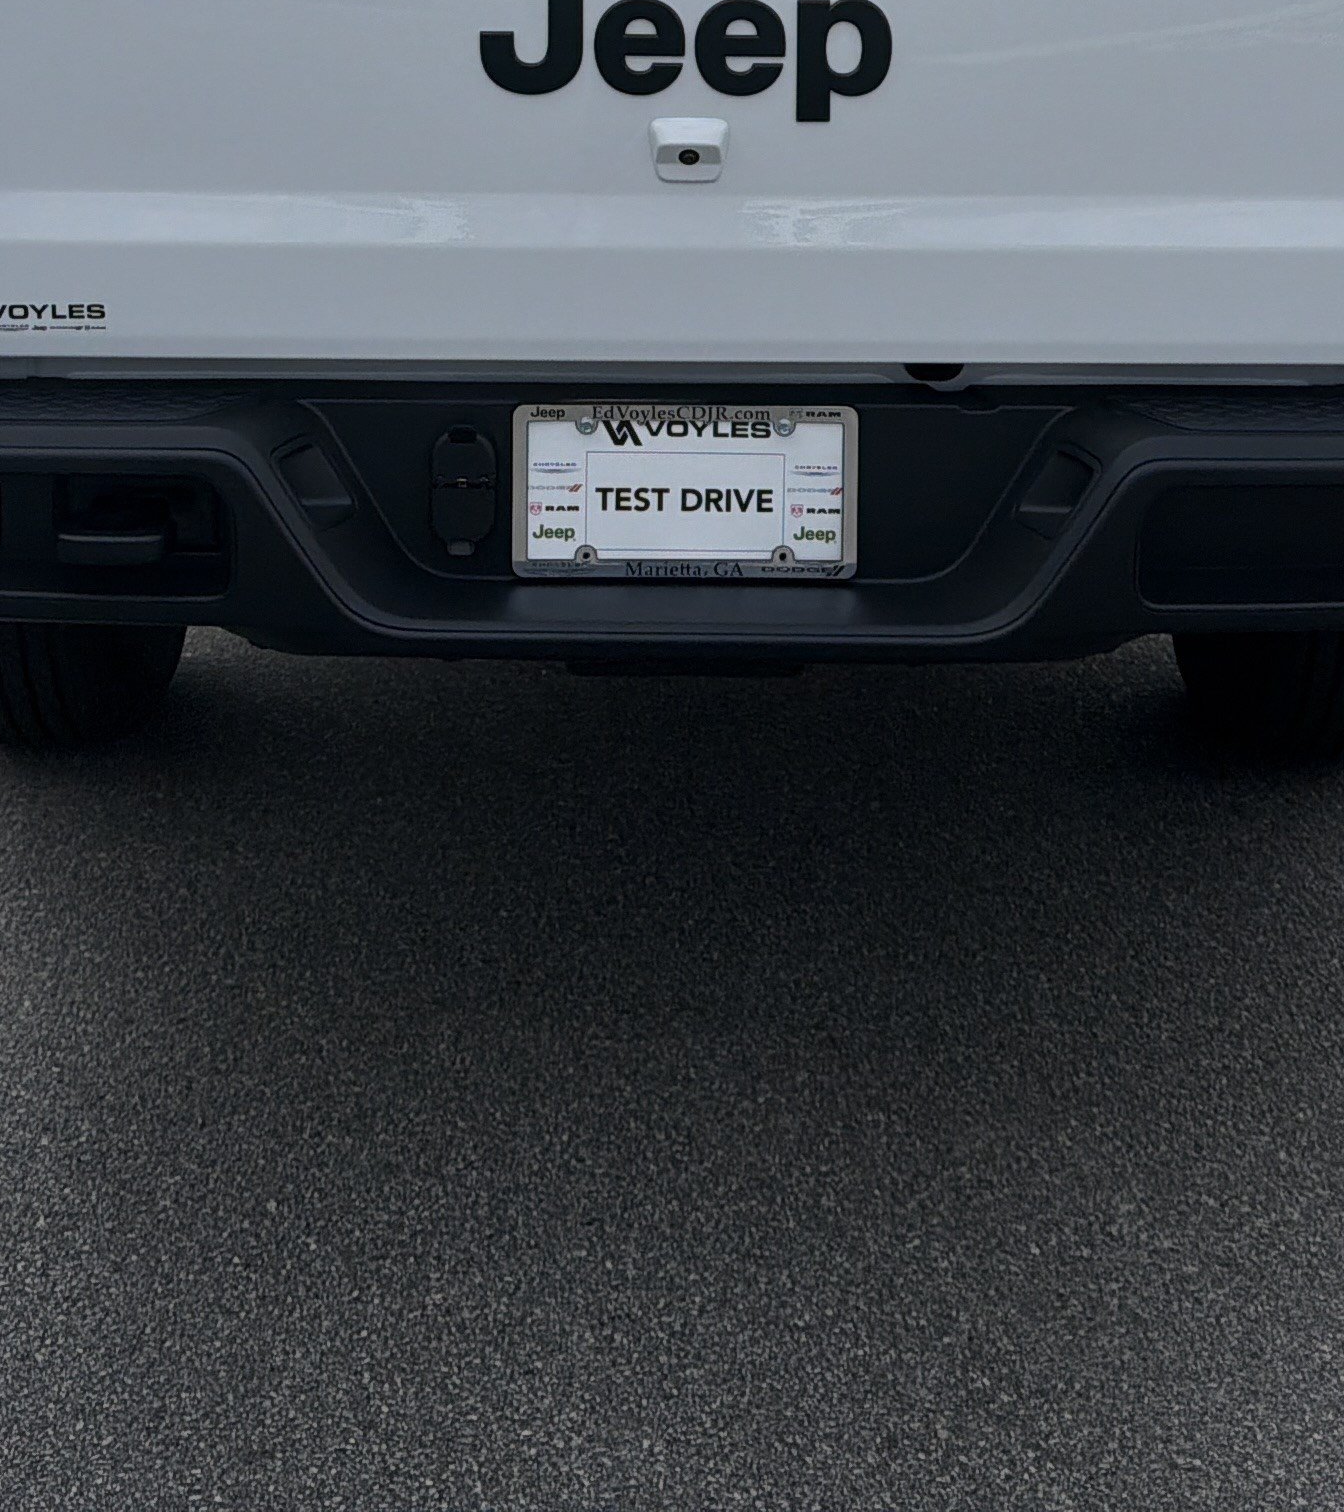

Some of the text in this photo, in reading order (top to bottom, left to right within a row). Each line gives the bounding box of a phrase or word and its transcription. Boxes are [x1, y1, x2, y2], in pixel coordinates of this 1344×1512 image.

[530, 406, 566, 420] Jeep
[592, 405, 771, 426] EdVoylesCDJR.com
[806, 410, 842, 418] RAM
[644, 420, 772, 438] VOYLES
[595, 487, 774, 513] TEST DRIVE
[532, 524, 575, 542] Jeep
[793, 525, 836, 543] Jeep
[625, 561, 744, 578] Marietta, GA
